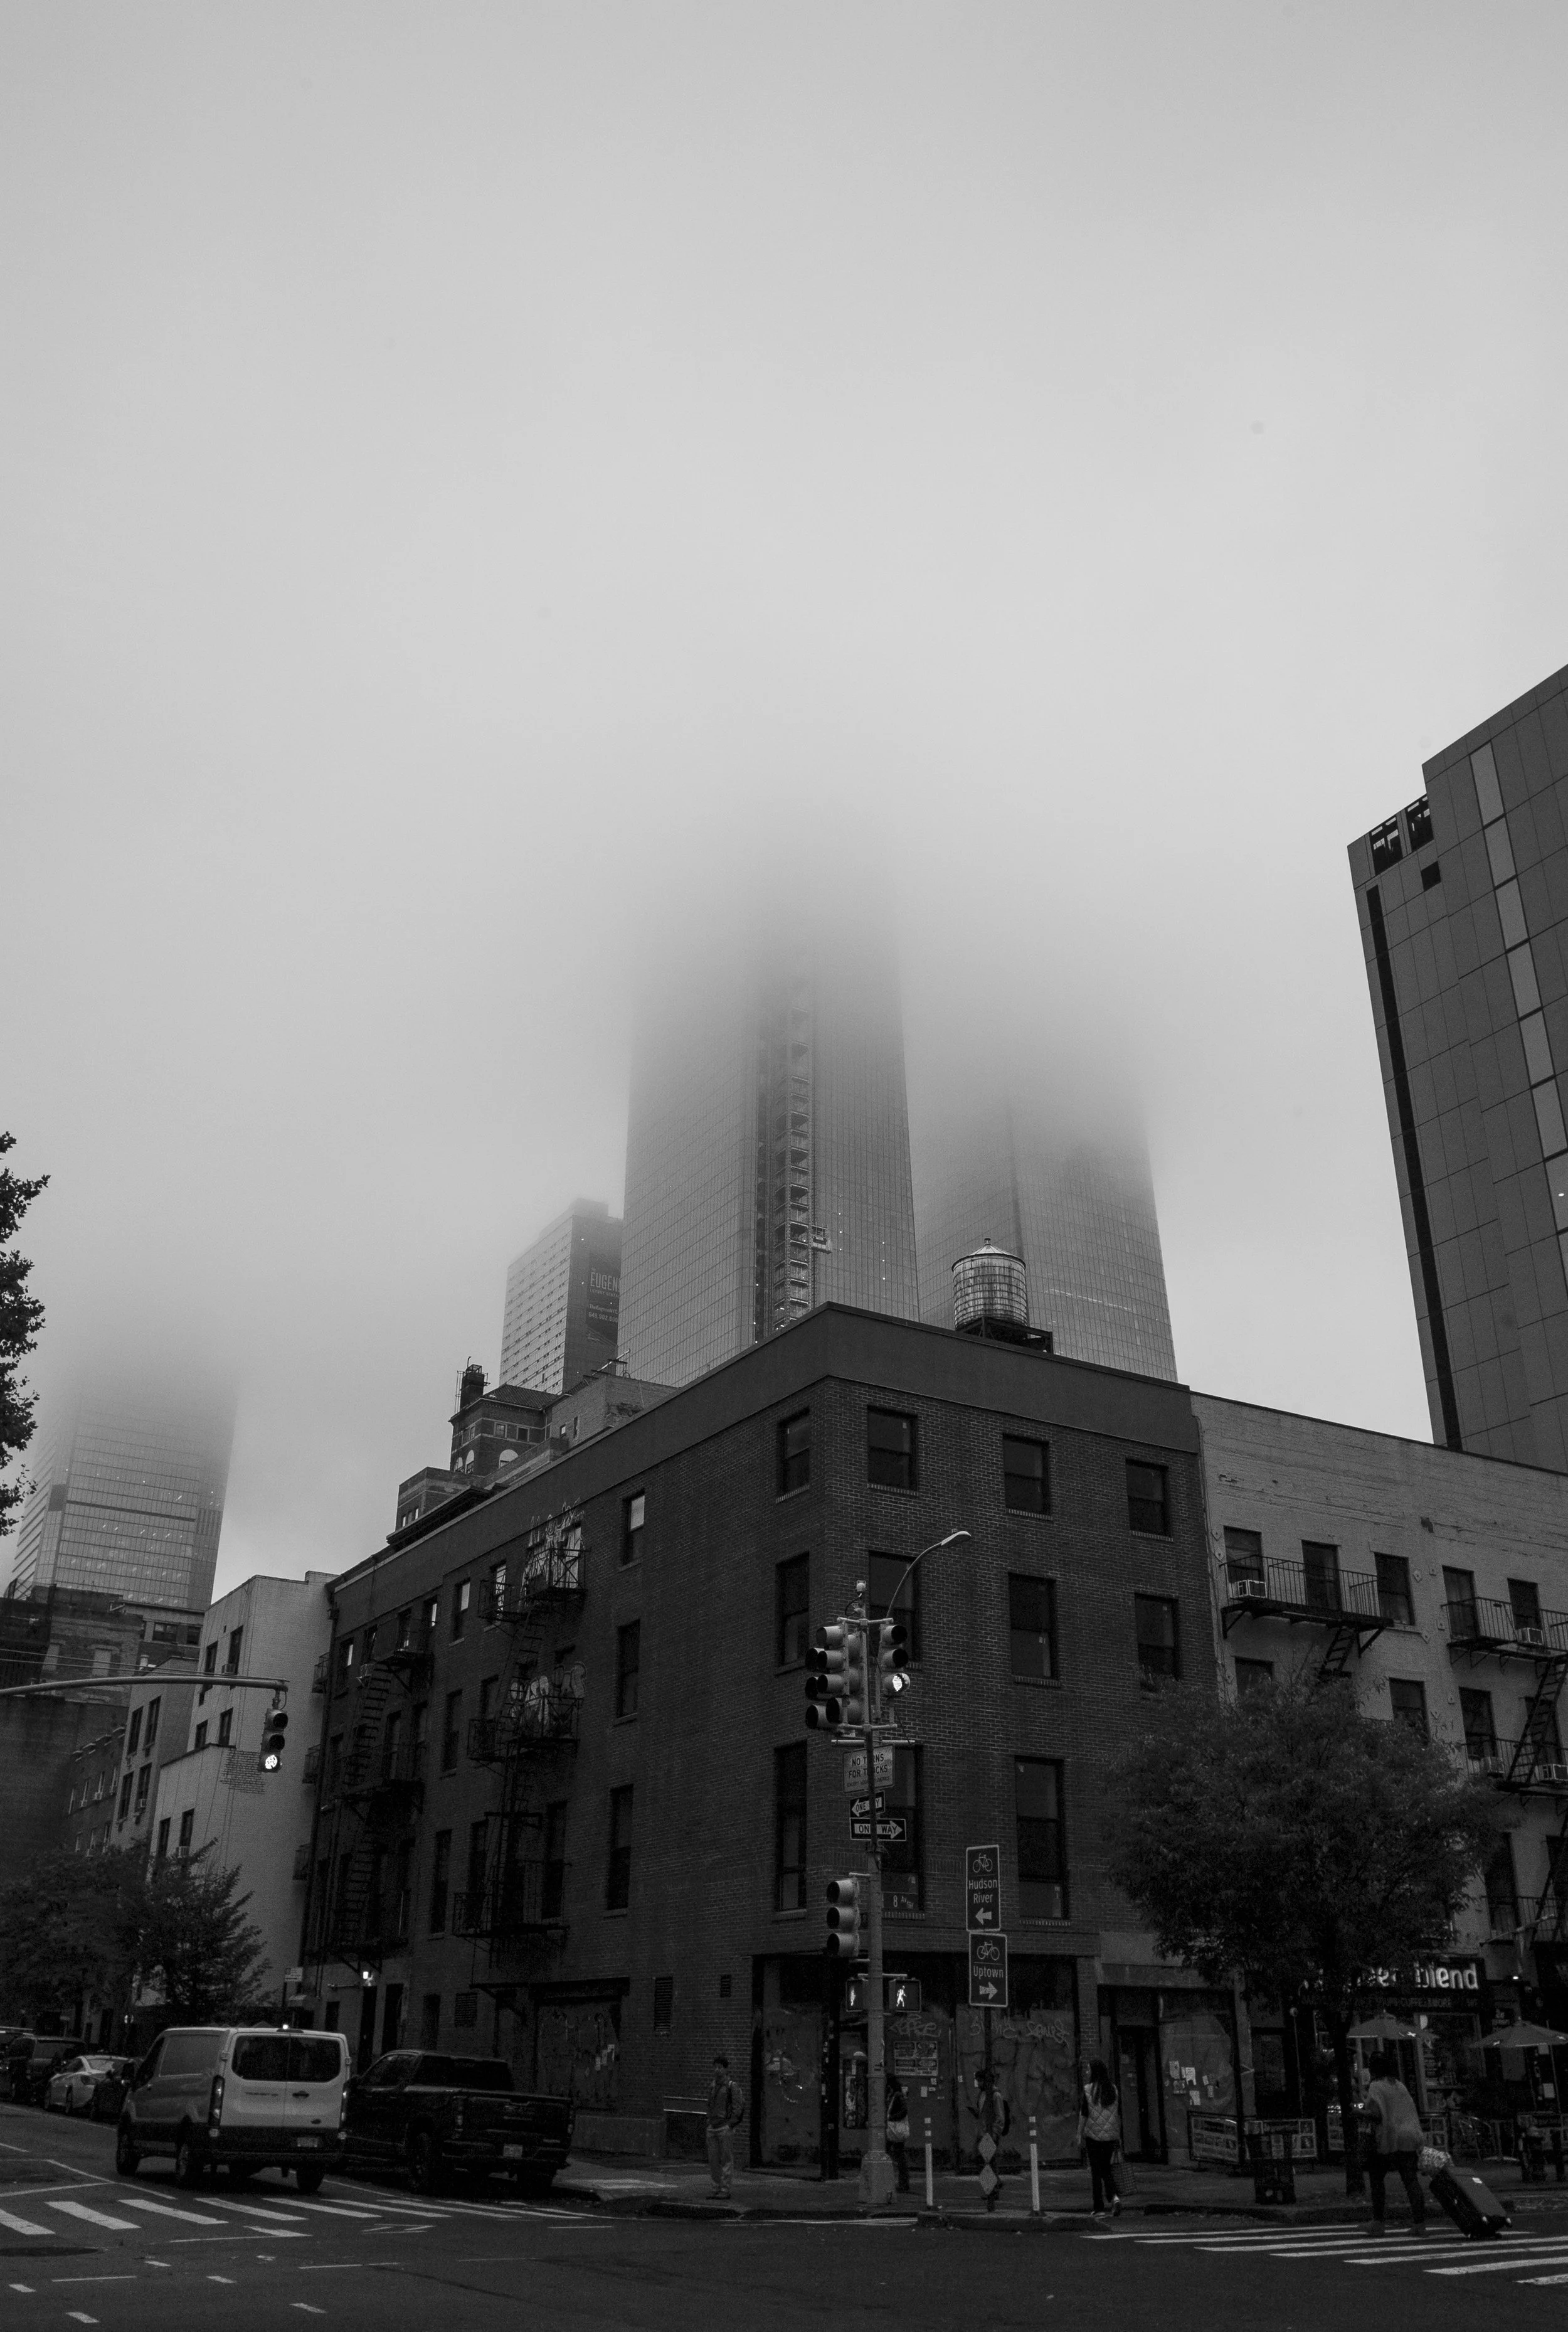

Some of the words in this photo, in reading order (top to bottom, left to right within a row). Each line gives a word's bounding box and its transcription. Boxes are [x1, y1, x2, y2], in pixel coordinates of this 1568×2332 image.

[590, 1272, 619, 1292] EUGEN
[852, 1757, 861, 1766] NO
[863, 1754, 884, 1765] TNS
[849, 1769, 861, 1779] FOR
[863, 1764, 888, 1777] TCKS
[856, 1802, 866, 1813] ONE
[859, 1824, 870, 1833] ON
[881, 1825, 898, 1834] WAY
[968, 1878, 997, 1890] Hudson
[893, 1895, 898, 1908] 8
[973, 1892, 993, 1904] River
[973, 1965, 1004, 1980] Uptown
